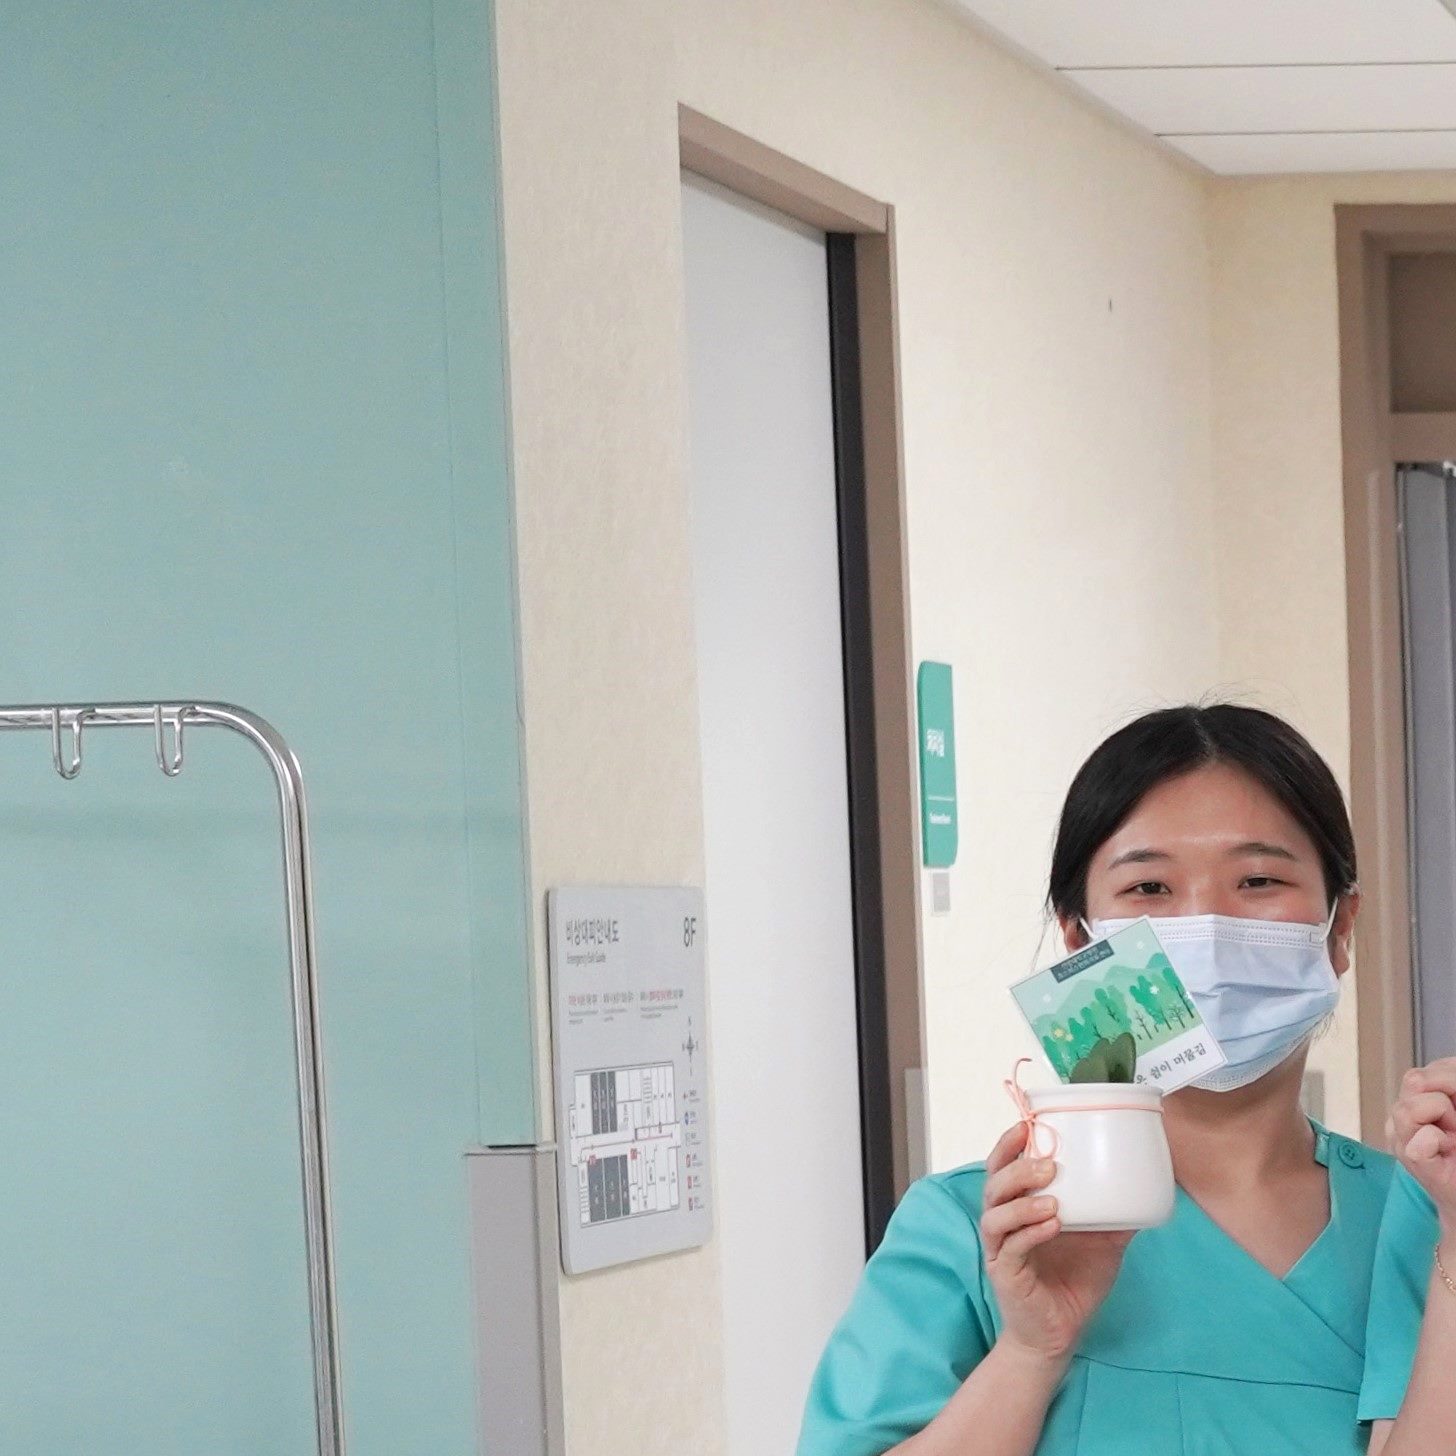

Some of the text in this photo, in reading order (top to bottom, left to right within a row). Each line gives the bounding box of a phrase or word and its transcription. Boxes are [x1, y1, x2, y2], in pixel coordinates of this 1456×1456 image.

[566, 918, 620, 945] 비상대피안내도
[684, 917, 697, 948] 8F
[1150, 1060, 1172, 1080] 쉼이
